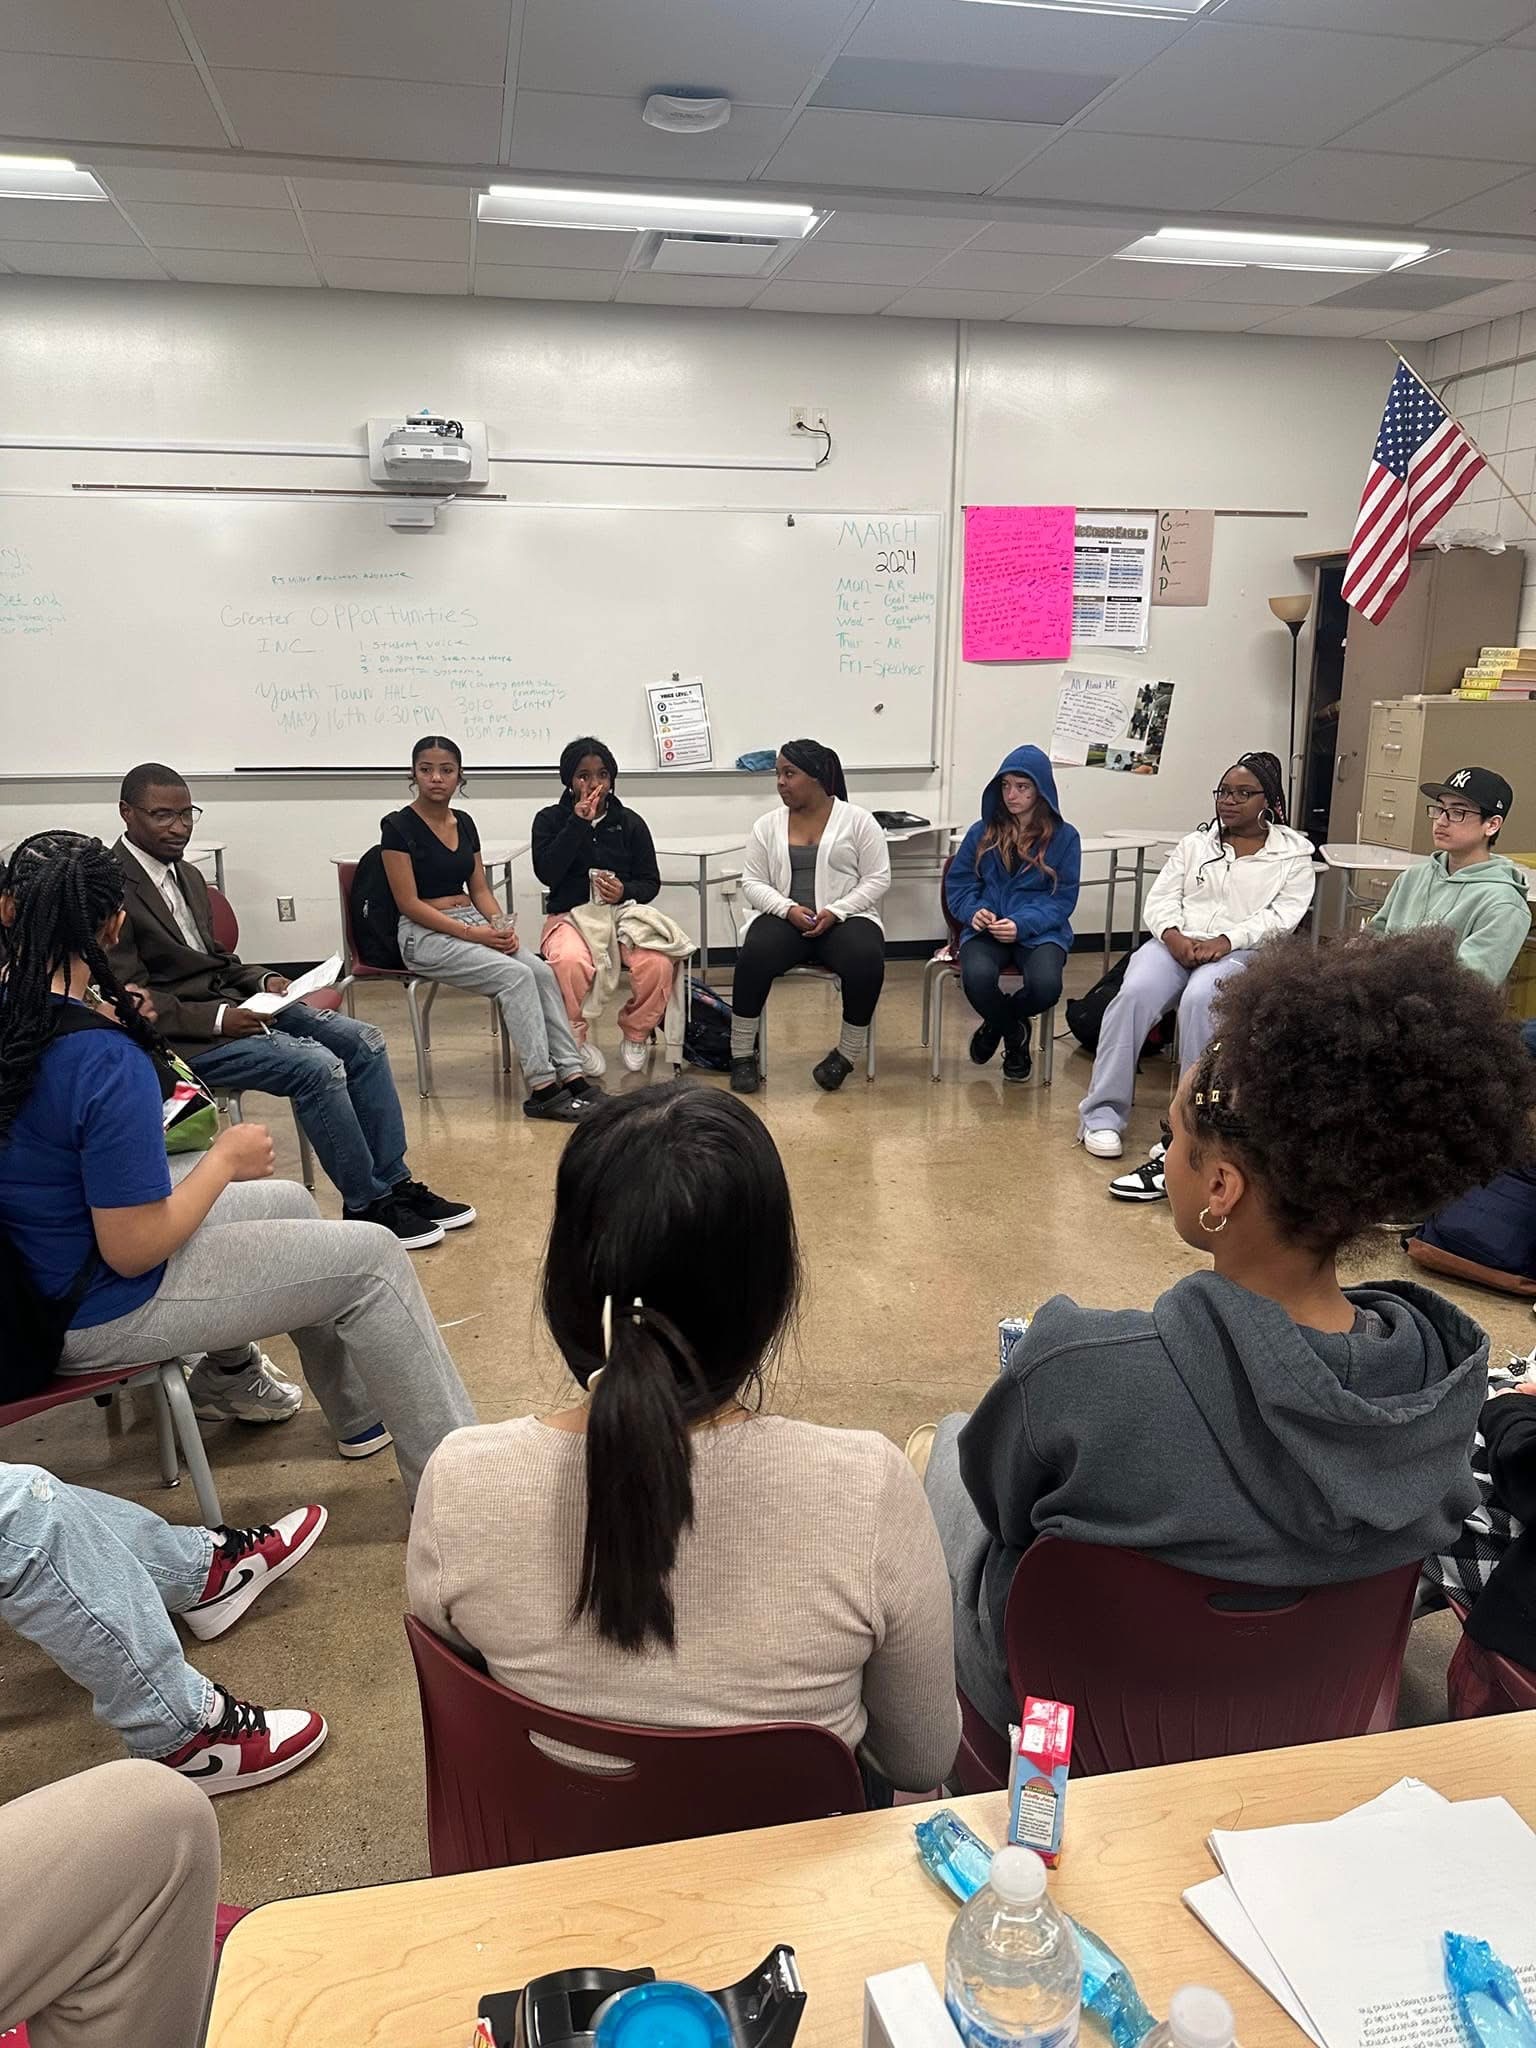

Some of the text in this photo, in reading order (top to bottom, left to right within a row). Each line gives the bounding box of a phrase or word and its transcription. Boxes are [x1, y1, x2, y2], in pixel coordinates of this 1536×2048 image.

[838, 520, 917, 549] MARCH
[1161, 536, 1170, 552] N
[875, 550, 916, 575] 2024
[1161, 555, 1170, 573] A
[836, 577, 870, 594] Mon
[888, 579, 904, 592] AR
[1159, 577, 1168, 596] P
[835, 594, 861, 611] Tue
[220, 604, 294, 628] Greater
[836, 616, 864, 627] Wed
[258, 638, 316, 653] INC
[840, 654, 861, 673] Fri
[256, 682, 320, 712] Youth
[328, 683, 374, 700] Town
[1450, 770, 1471, 788] NY
